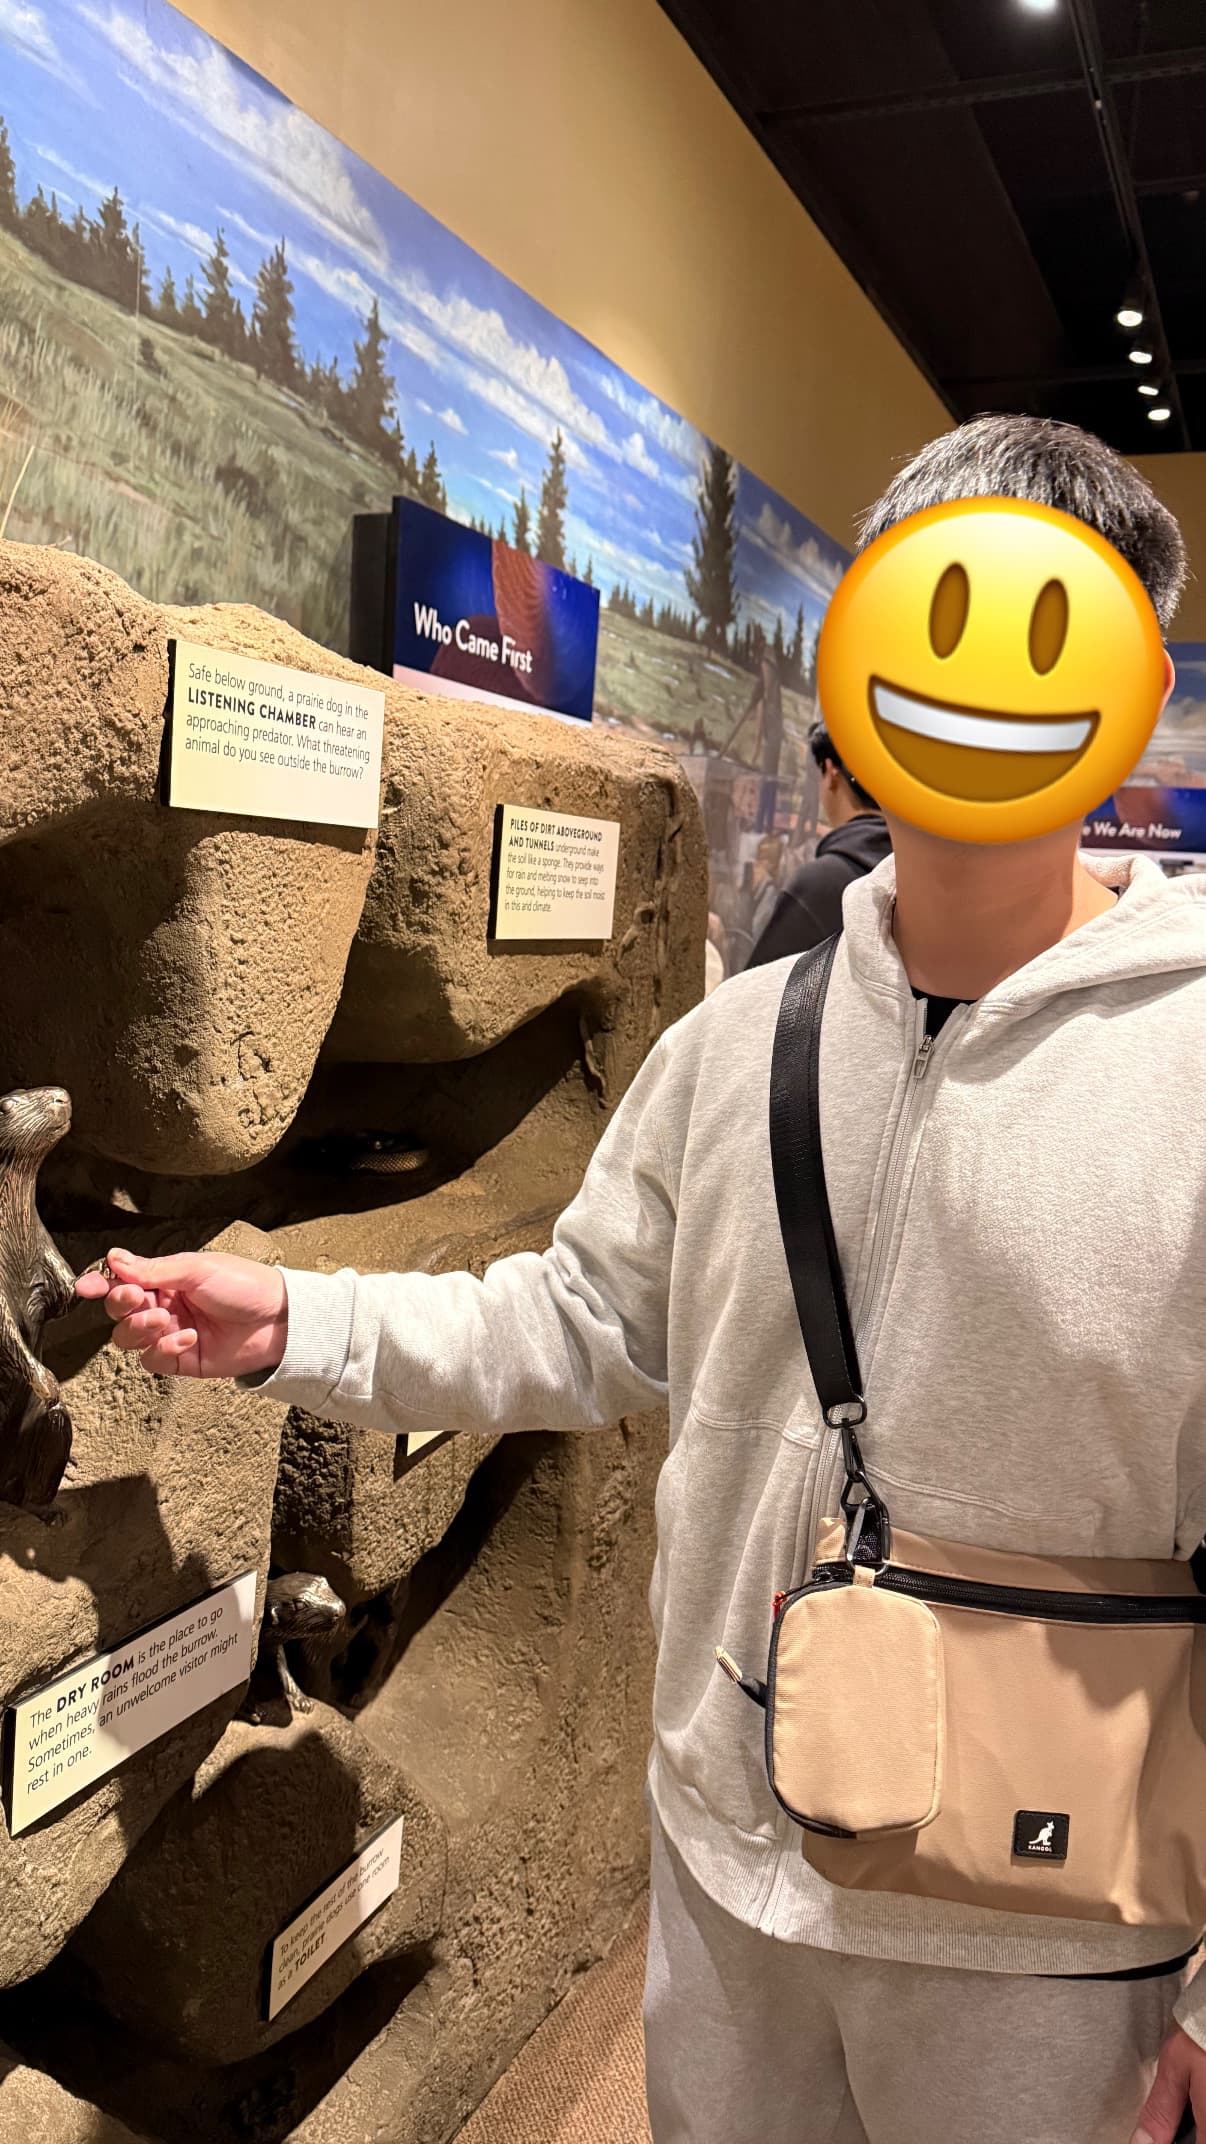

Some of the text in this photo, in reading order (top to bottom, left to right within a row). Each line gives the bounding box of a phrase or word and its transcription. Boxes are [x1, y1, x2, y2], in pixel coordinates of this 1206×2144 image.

[414, 602, 533, 674] Who Came First
[188, 662, 369, 720] Safe below ground, a prairie dog in the
[188, 686, 367, 741] LISTENING CHAMBER can hear an
[185, 736, 364, 780] animal do you see outside the burrow?
[186, 714, 370, 765] approaching predator. What threatening
[508, 836, 523, 848] AND
[525, 837, 555, 852] TUNNELS
[510, 818, 603, 842] PILES OF DIRT ABOVEGROUND
[1094, 821, 1117, 837] We
[1118, 823, 1146, 838] Are
[1147, 824, 1182, 839] Now
[29, 1628, 219, 1751] when heavy rains flood the burrow.
[30, 1607, 223, 1729] The DRY ROOM is the place to go
[28, 1633, 238, 1773] Sometimes, an unwelcome visitor might
[27, 1746, 93, 1794] rest in one.
